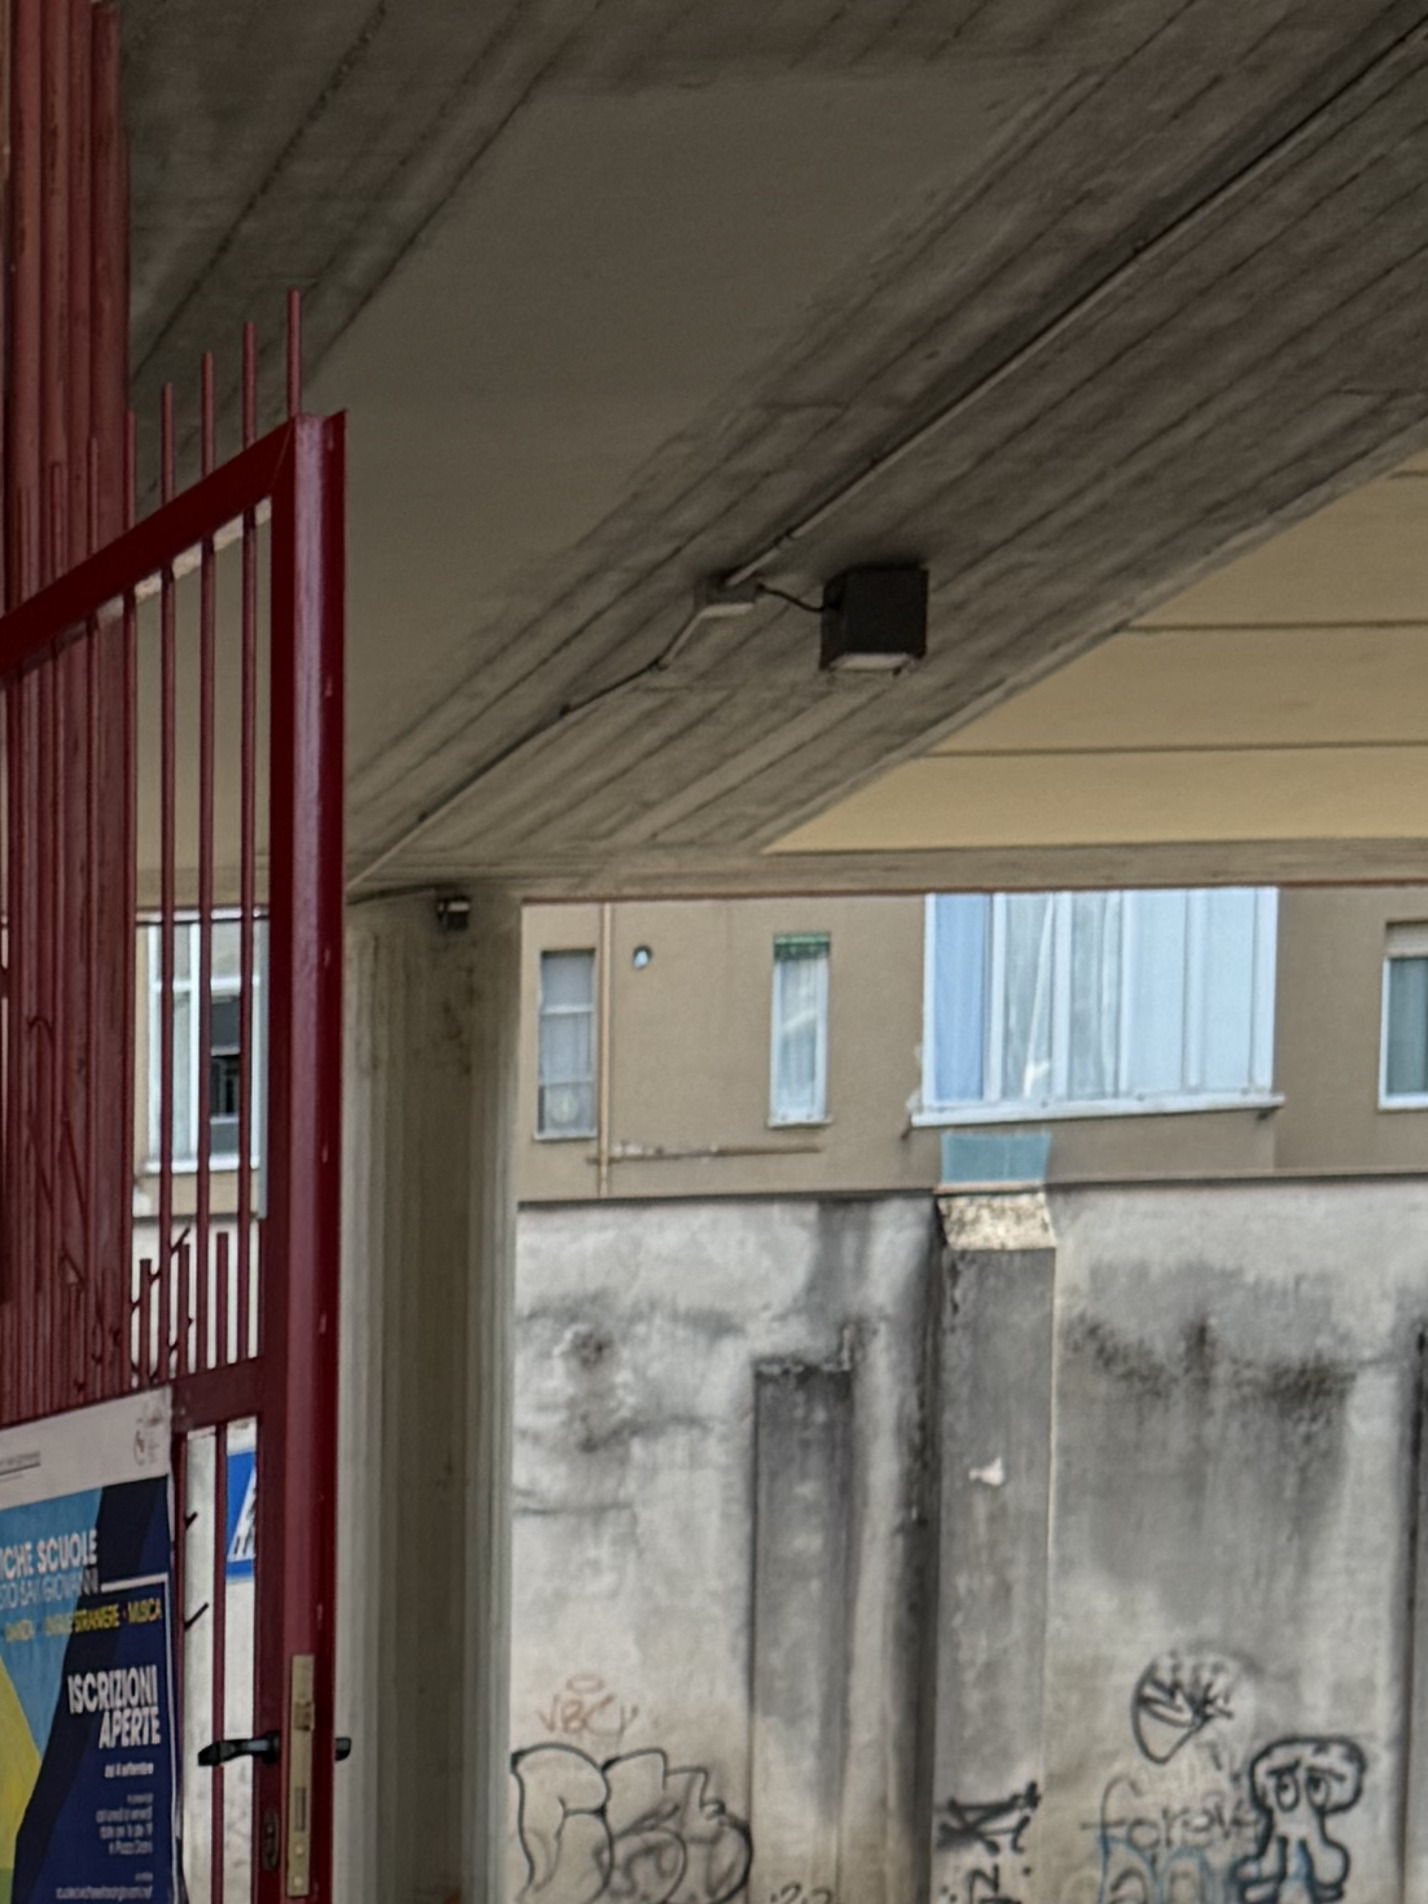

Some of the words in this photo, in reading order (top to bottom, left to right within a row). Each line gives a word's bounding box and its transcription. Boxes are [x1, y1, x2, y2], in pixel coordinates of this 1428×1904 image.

[37, 1529, 97, 1573] SCUOLE
[67, 1664, 157, 1714] ISCRIZIONI
[98, 1706, 161, 1749] APERTE
